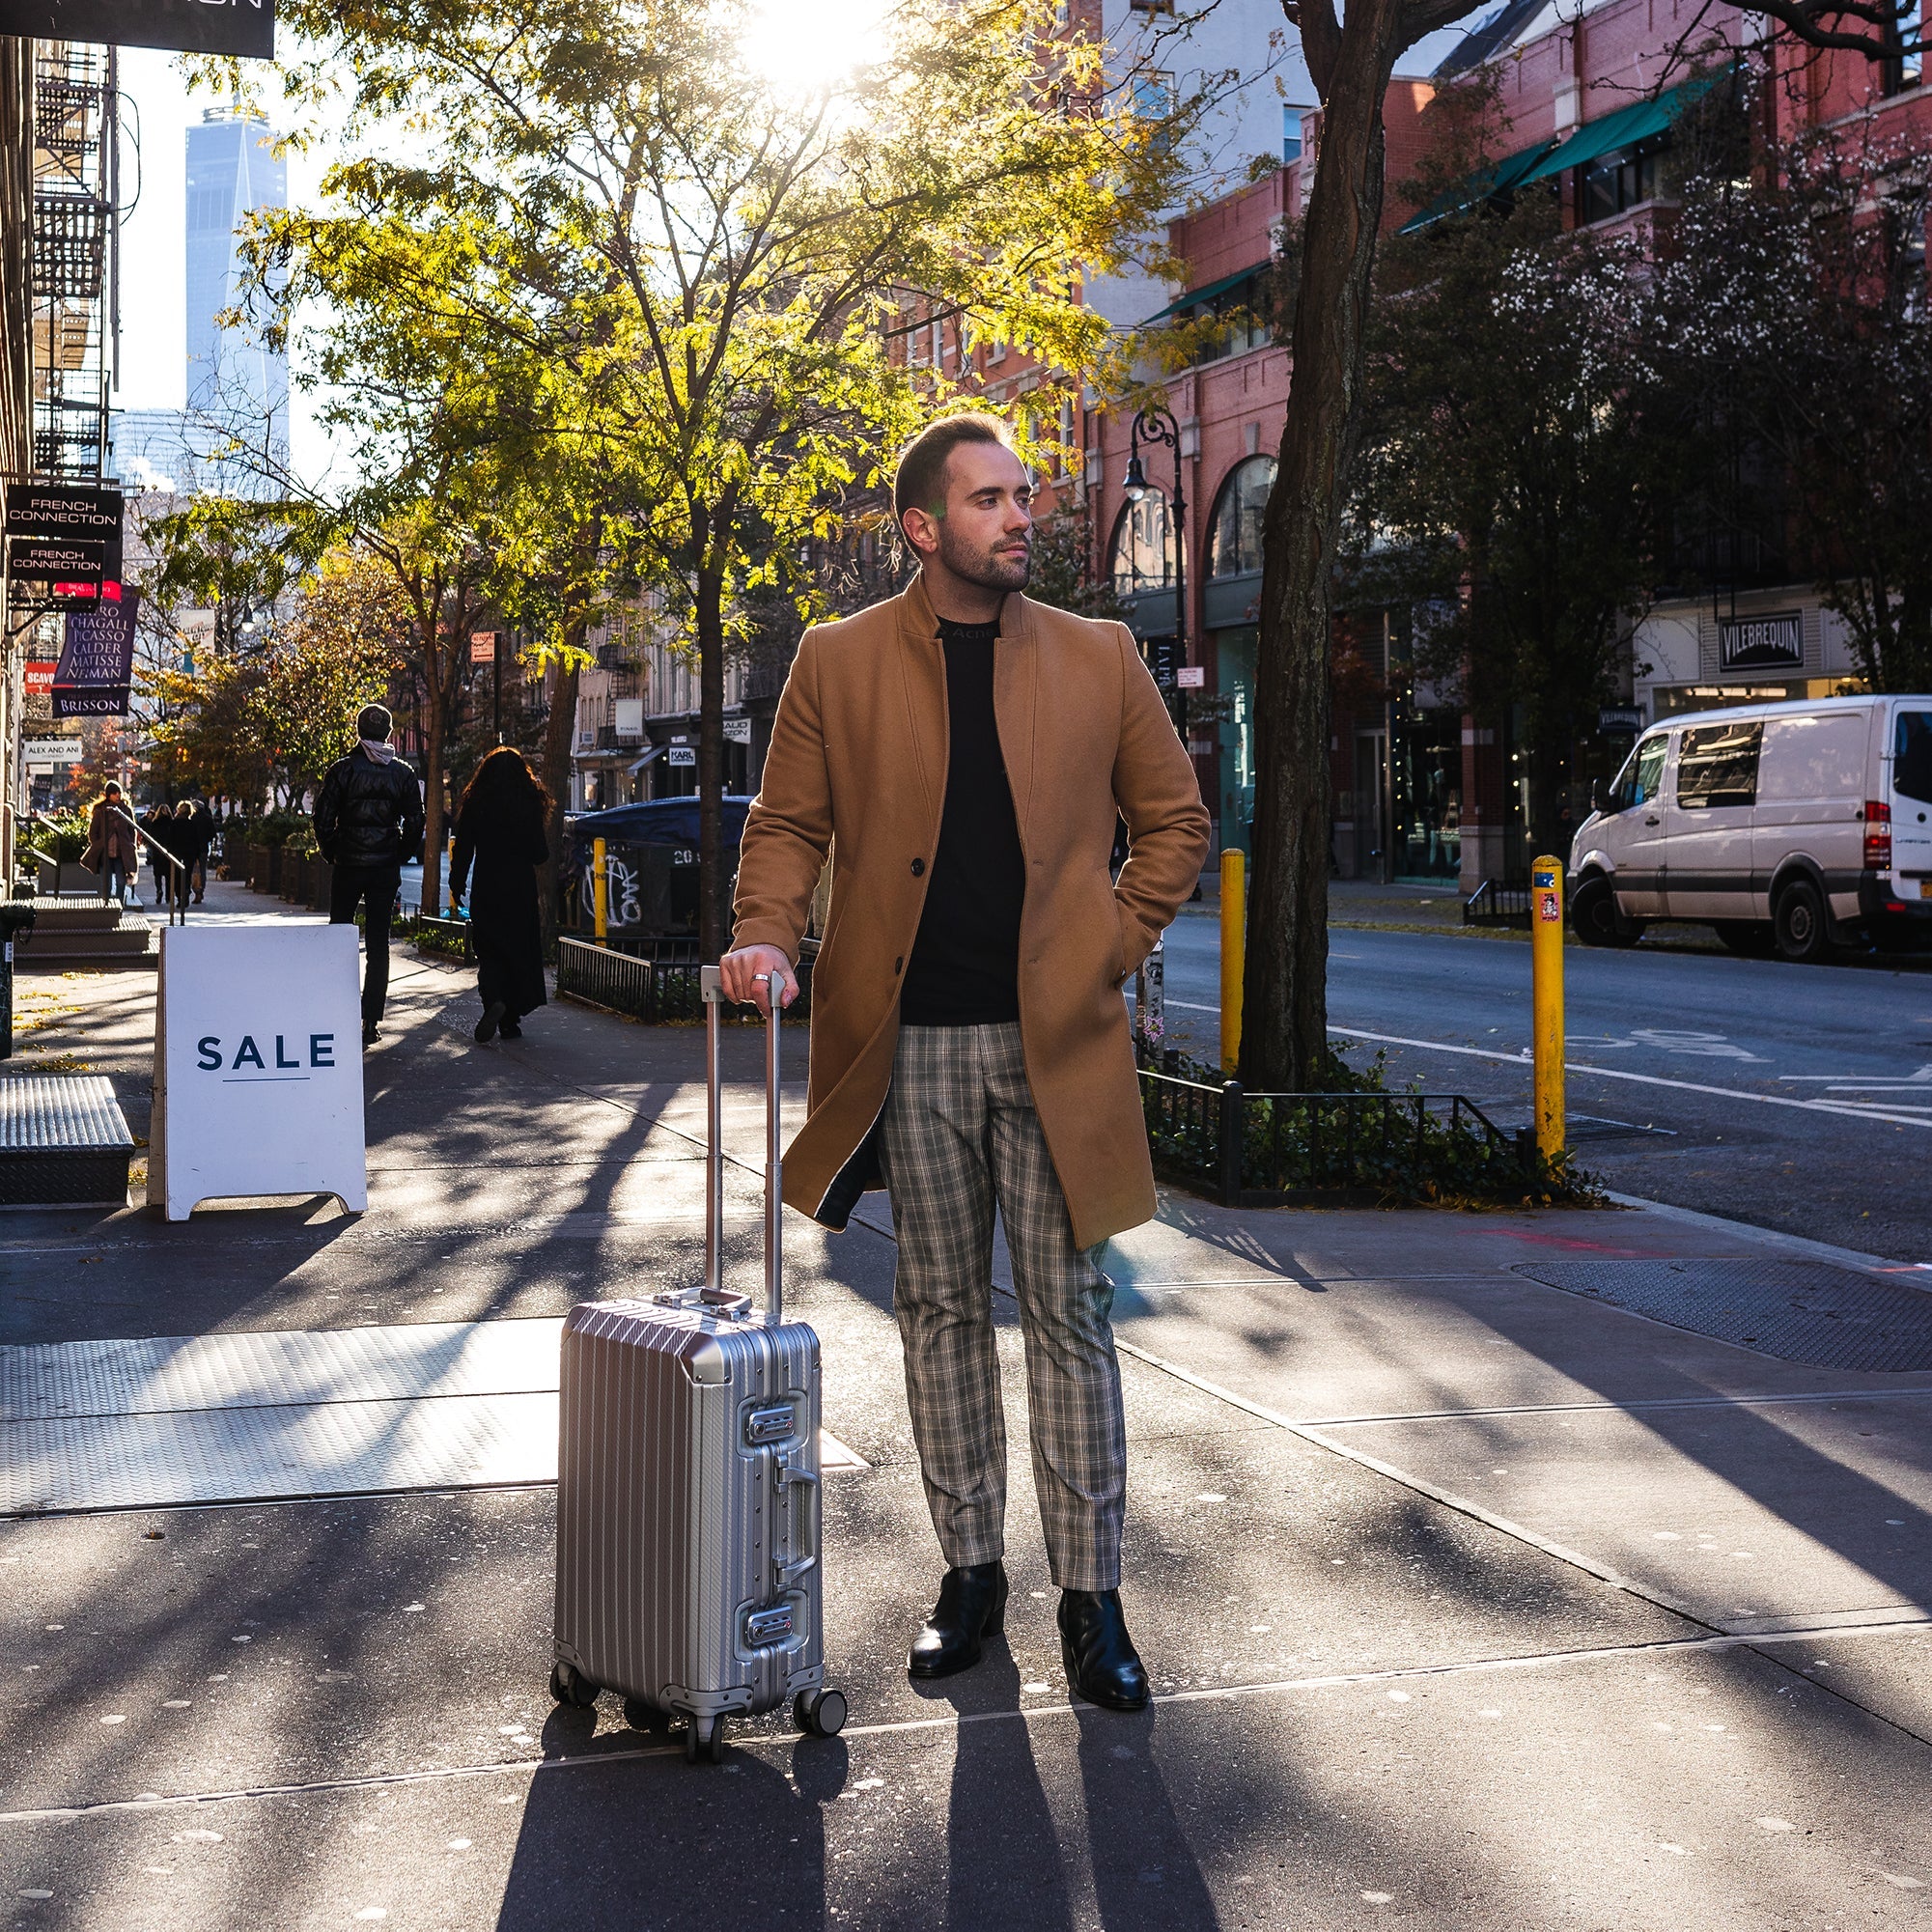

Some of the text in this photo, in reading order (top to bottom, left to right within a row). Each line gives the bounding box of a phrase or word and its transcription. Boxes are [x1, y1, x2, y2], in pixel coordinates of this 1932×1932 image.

[31, 498, 97, 512] FRENCH
[10, 510, 117, 525] CONNECTION
[30, 549, 84, 560] FRENCH
[13, 559, 101, 571] CONNECTION
[70, 617, 129, 631] CHAGALL
[73, 630, 126, 643] PICASSO
[1722, 620, 1800, 664] VILEBREQUIN
[73, 642, 122, 656] CALDER
[70, 655, 123, 668] MATISSE
[60, 699, 120, 713] BRISSON
[196, 1033, 335, 1071] SALE
